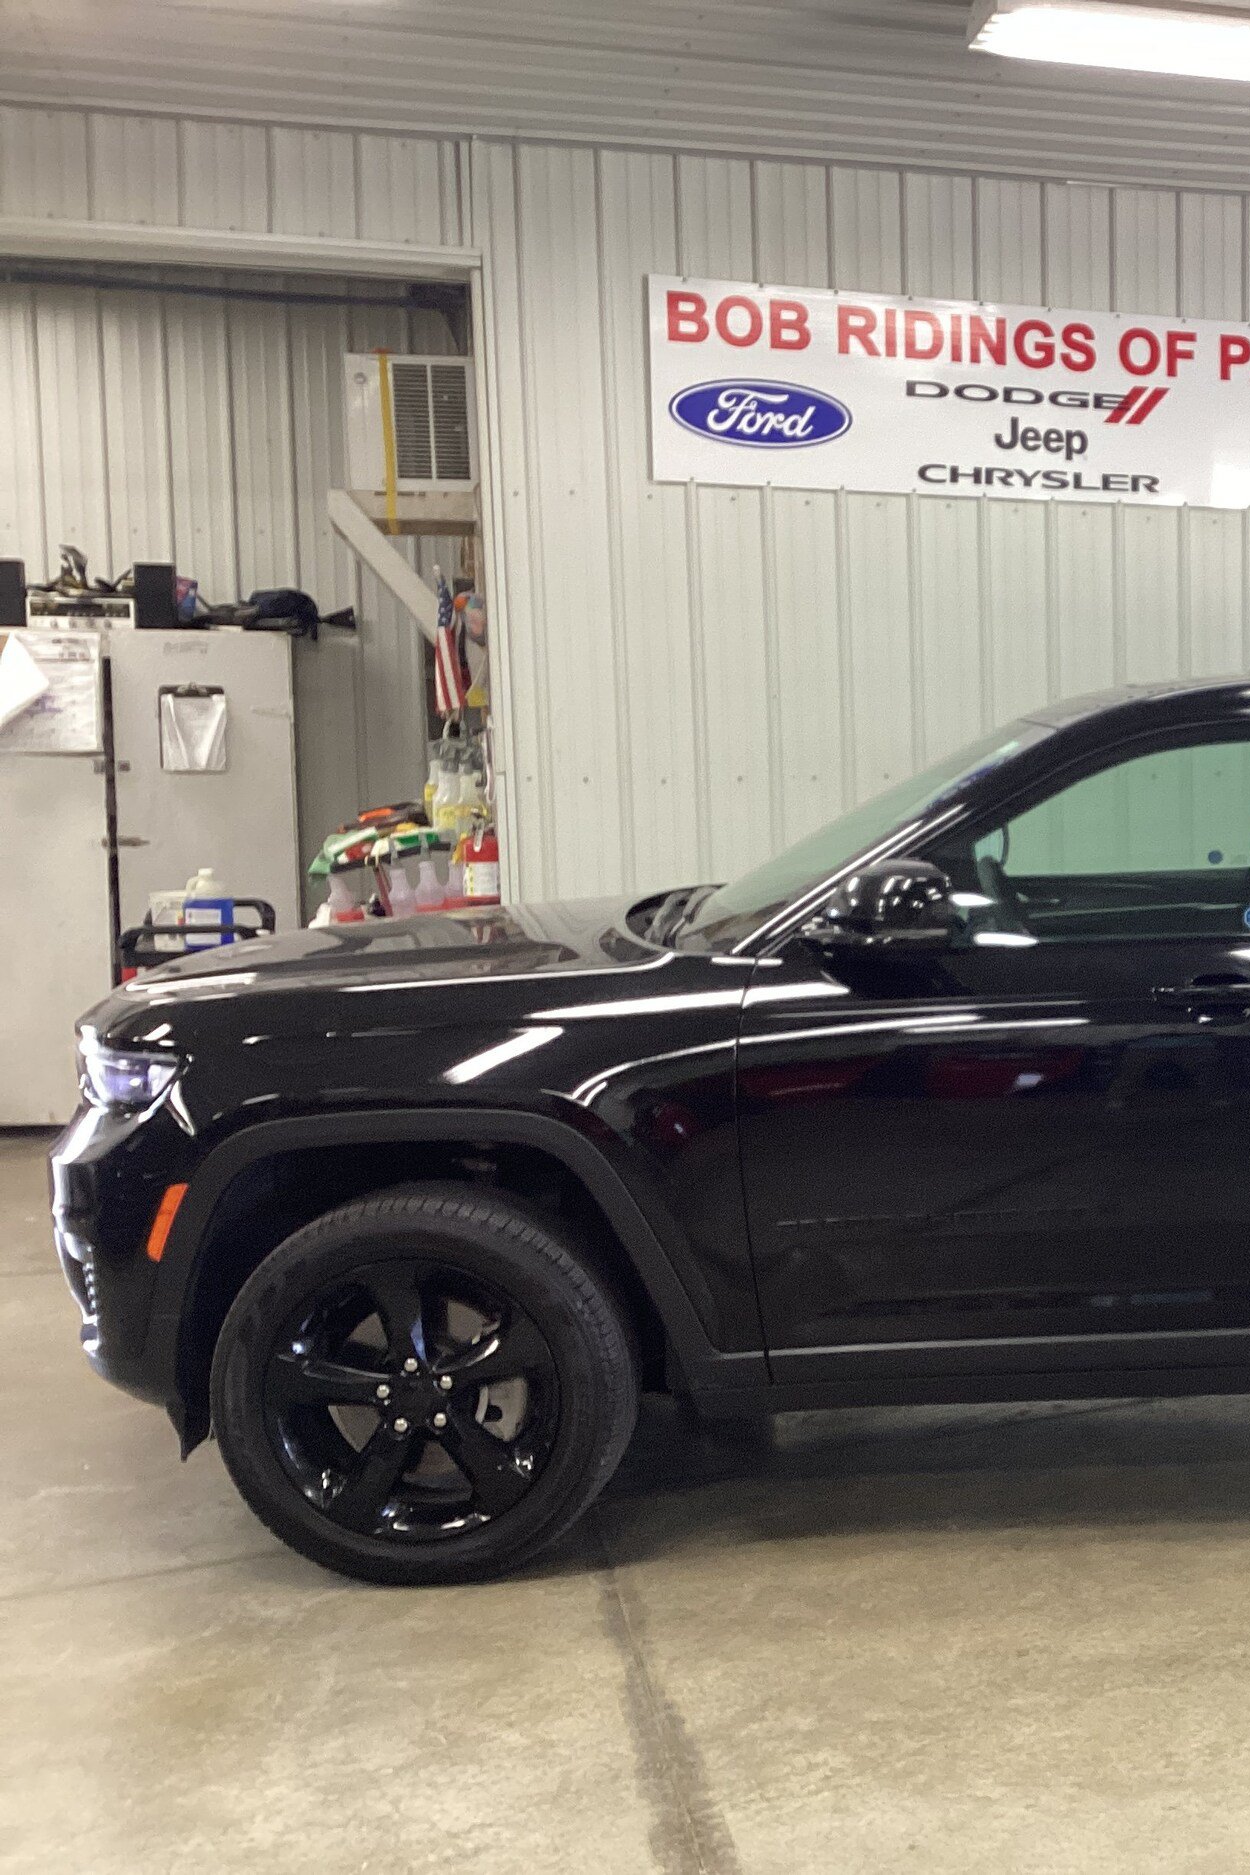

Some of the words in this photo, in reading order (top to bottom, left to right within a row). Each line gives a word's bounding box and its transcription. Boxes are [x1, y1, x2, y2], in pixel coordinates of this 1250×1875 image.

[666, 290, 812, 351] BOB
[837, 304, 1097, 373] RIDINGS
[1118, 326, 1197, 377] OF
[706, 387, 816, 438] Ford
[905, 379, 1133, 411] DODGE
[994, 416, 1089, 461] Jeep
[917, 463, 1160, 493] CHRYSLER
